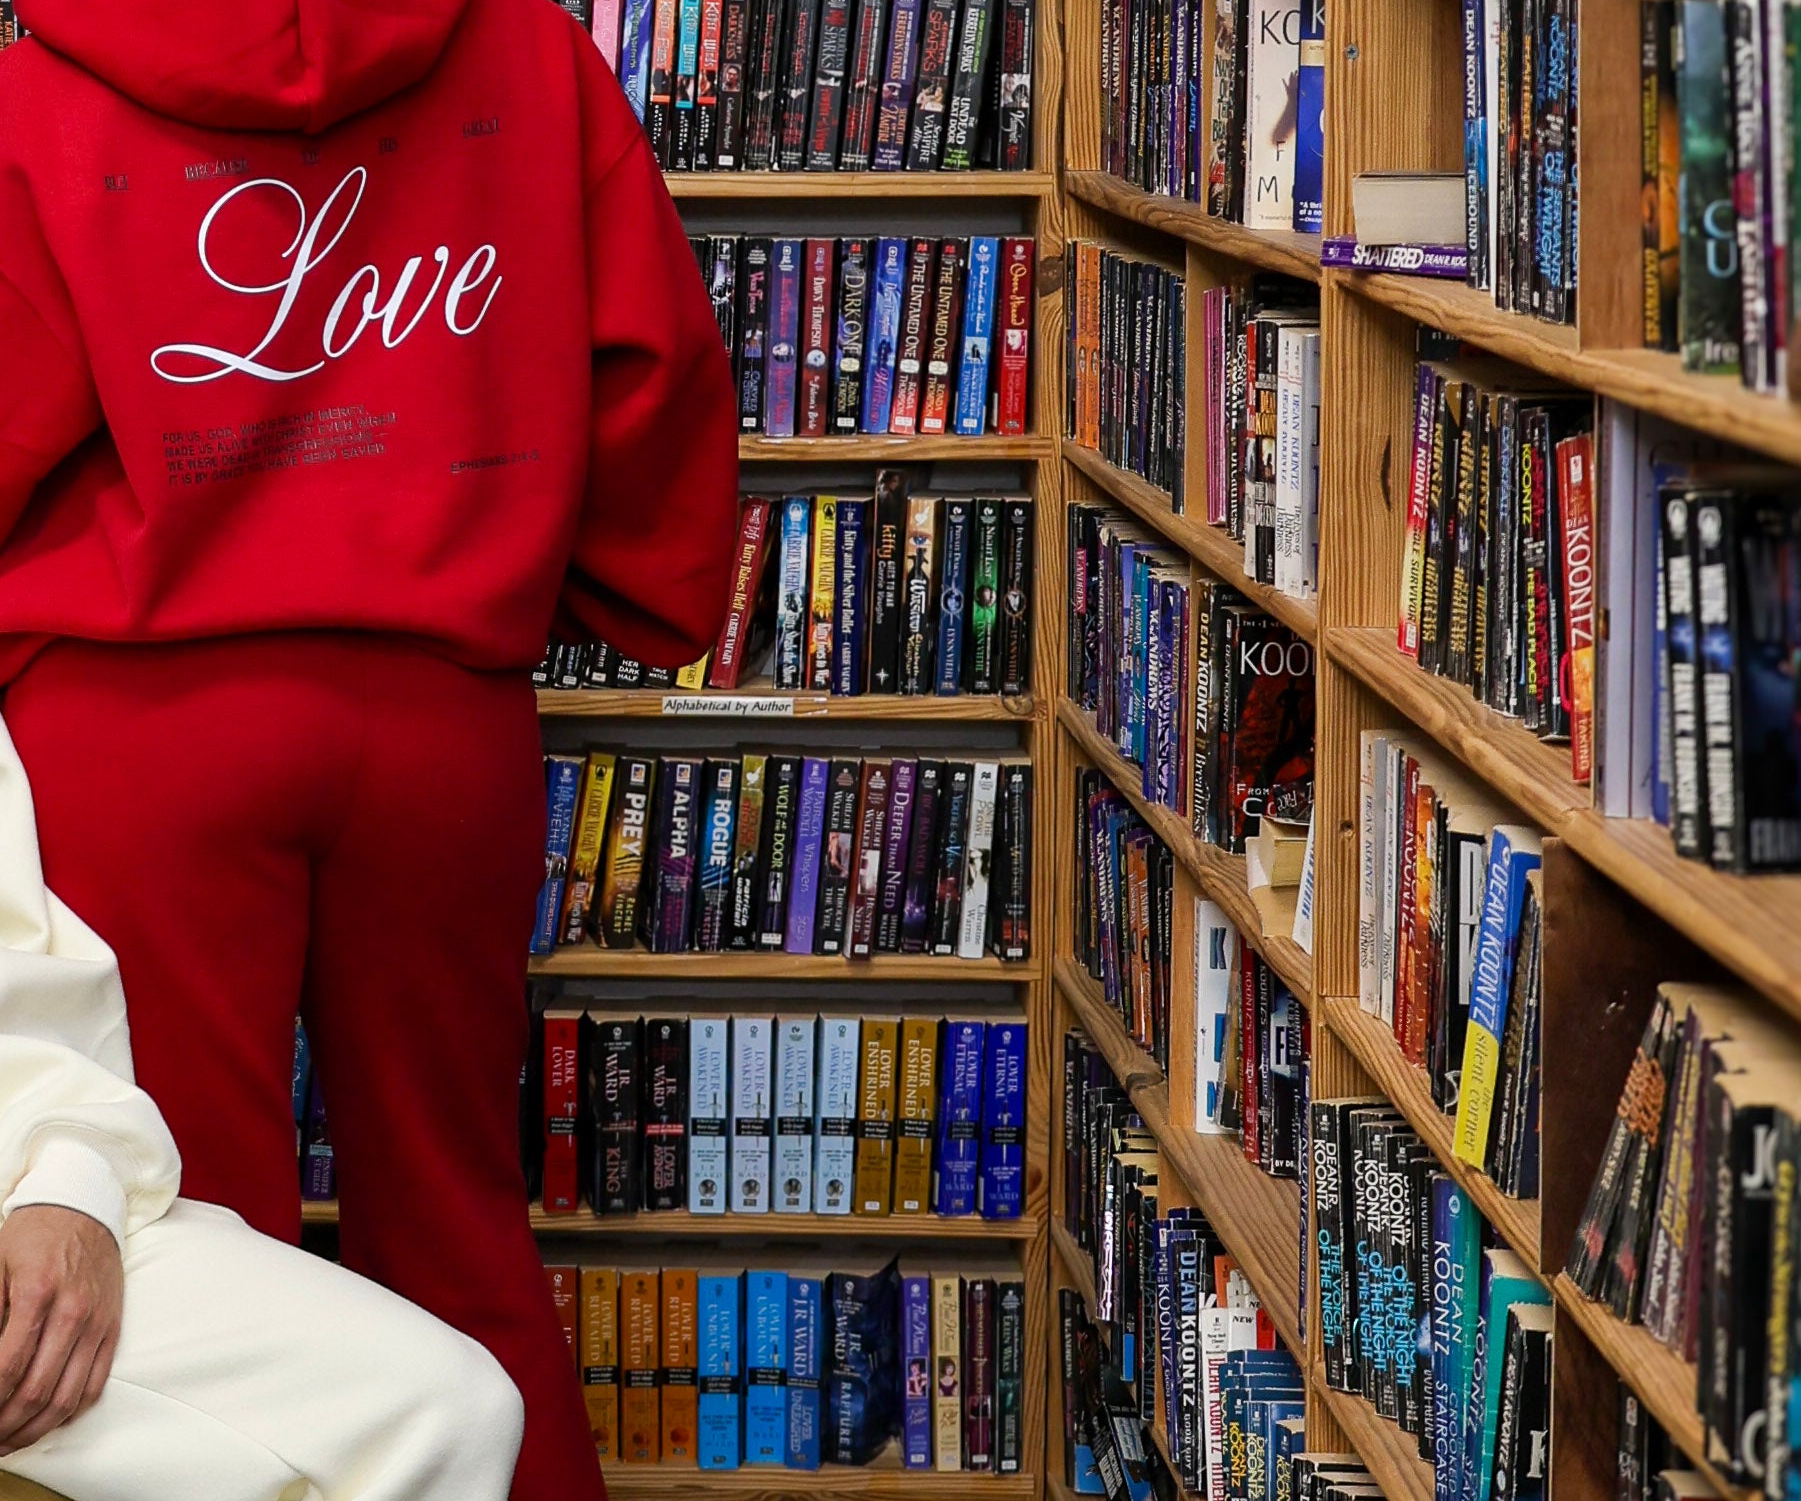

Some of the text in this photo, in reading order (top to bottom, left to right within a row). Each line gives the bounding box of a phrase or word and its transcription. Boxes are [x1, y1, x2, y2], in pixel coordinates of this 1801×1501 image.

[150, 166, 502, 383] Love
[1566, 525, 1595, 649] KOONTZ
[664, 699, 791, 714] Alphabetical by Author
[623, 791, 647, 857] PREY
[670, 789, 691, 860] ALPHA
[712, 798, 733, 868] ROGUE
[1486, 862, 1511, 930] DEAN
[1471, 932, 1502, 1033] KOONTZ
[553, 1046, 577, 1088] DARK LOVER
[1313, 1140, 1339, 1211] DEAN KOONTZ
[1434, 1240, 1465, 1494] KOONTZ DEAN STAIRCASE
